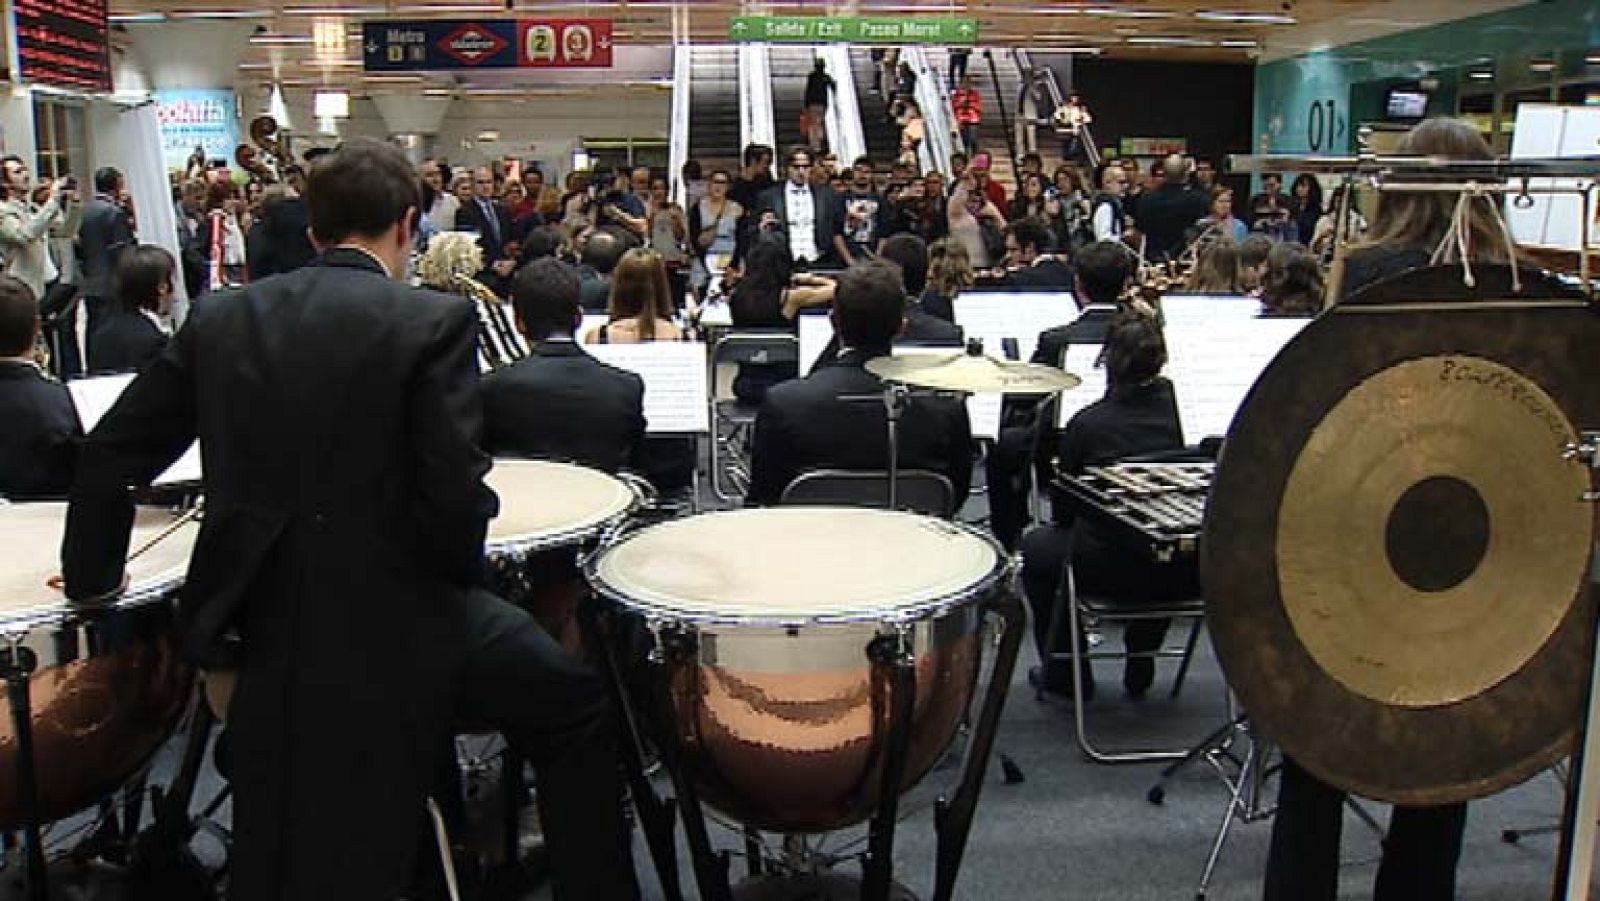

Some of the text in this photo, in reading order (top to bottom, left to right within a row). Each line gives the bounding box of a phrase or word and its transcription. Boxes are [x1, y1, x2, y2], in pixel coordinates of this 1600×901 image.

[386, 28, 426, 43] Metro
[764, 22, 805, 37] Salida
[1308, 99, 1335, 151] 01
